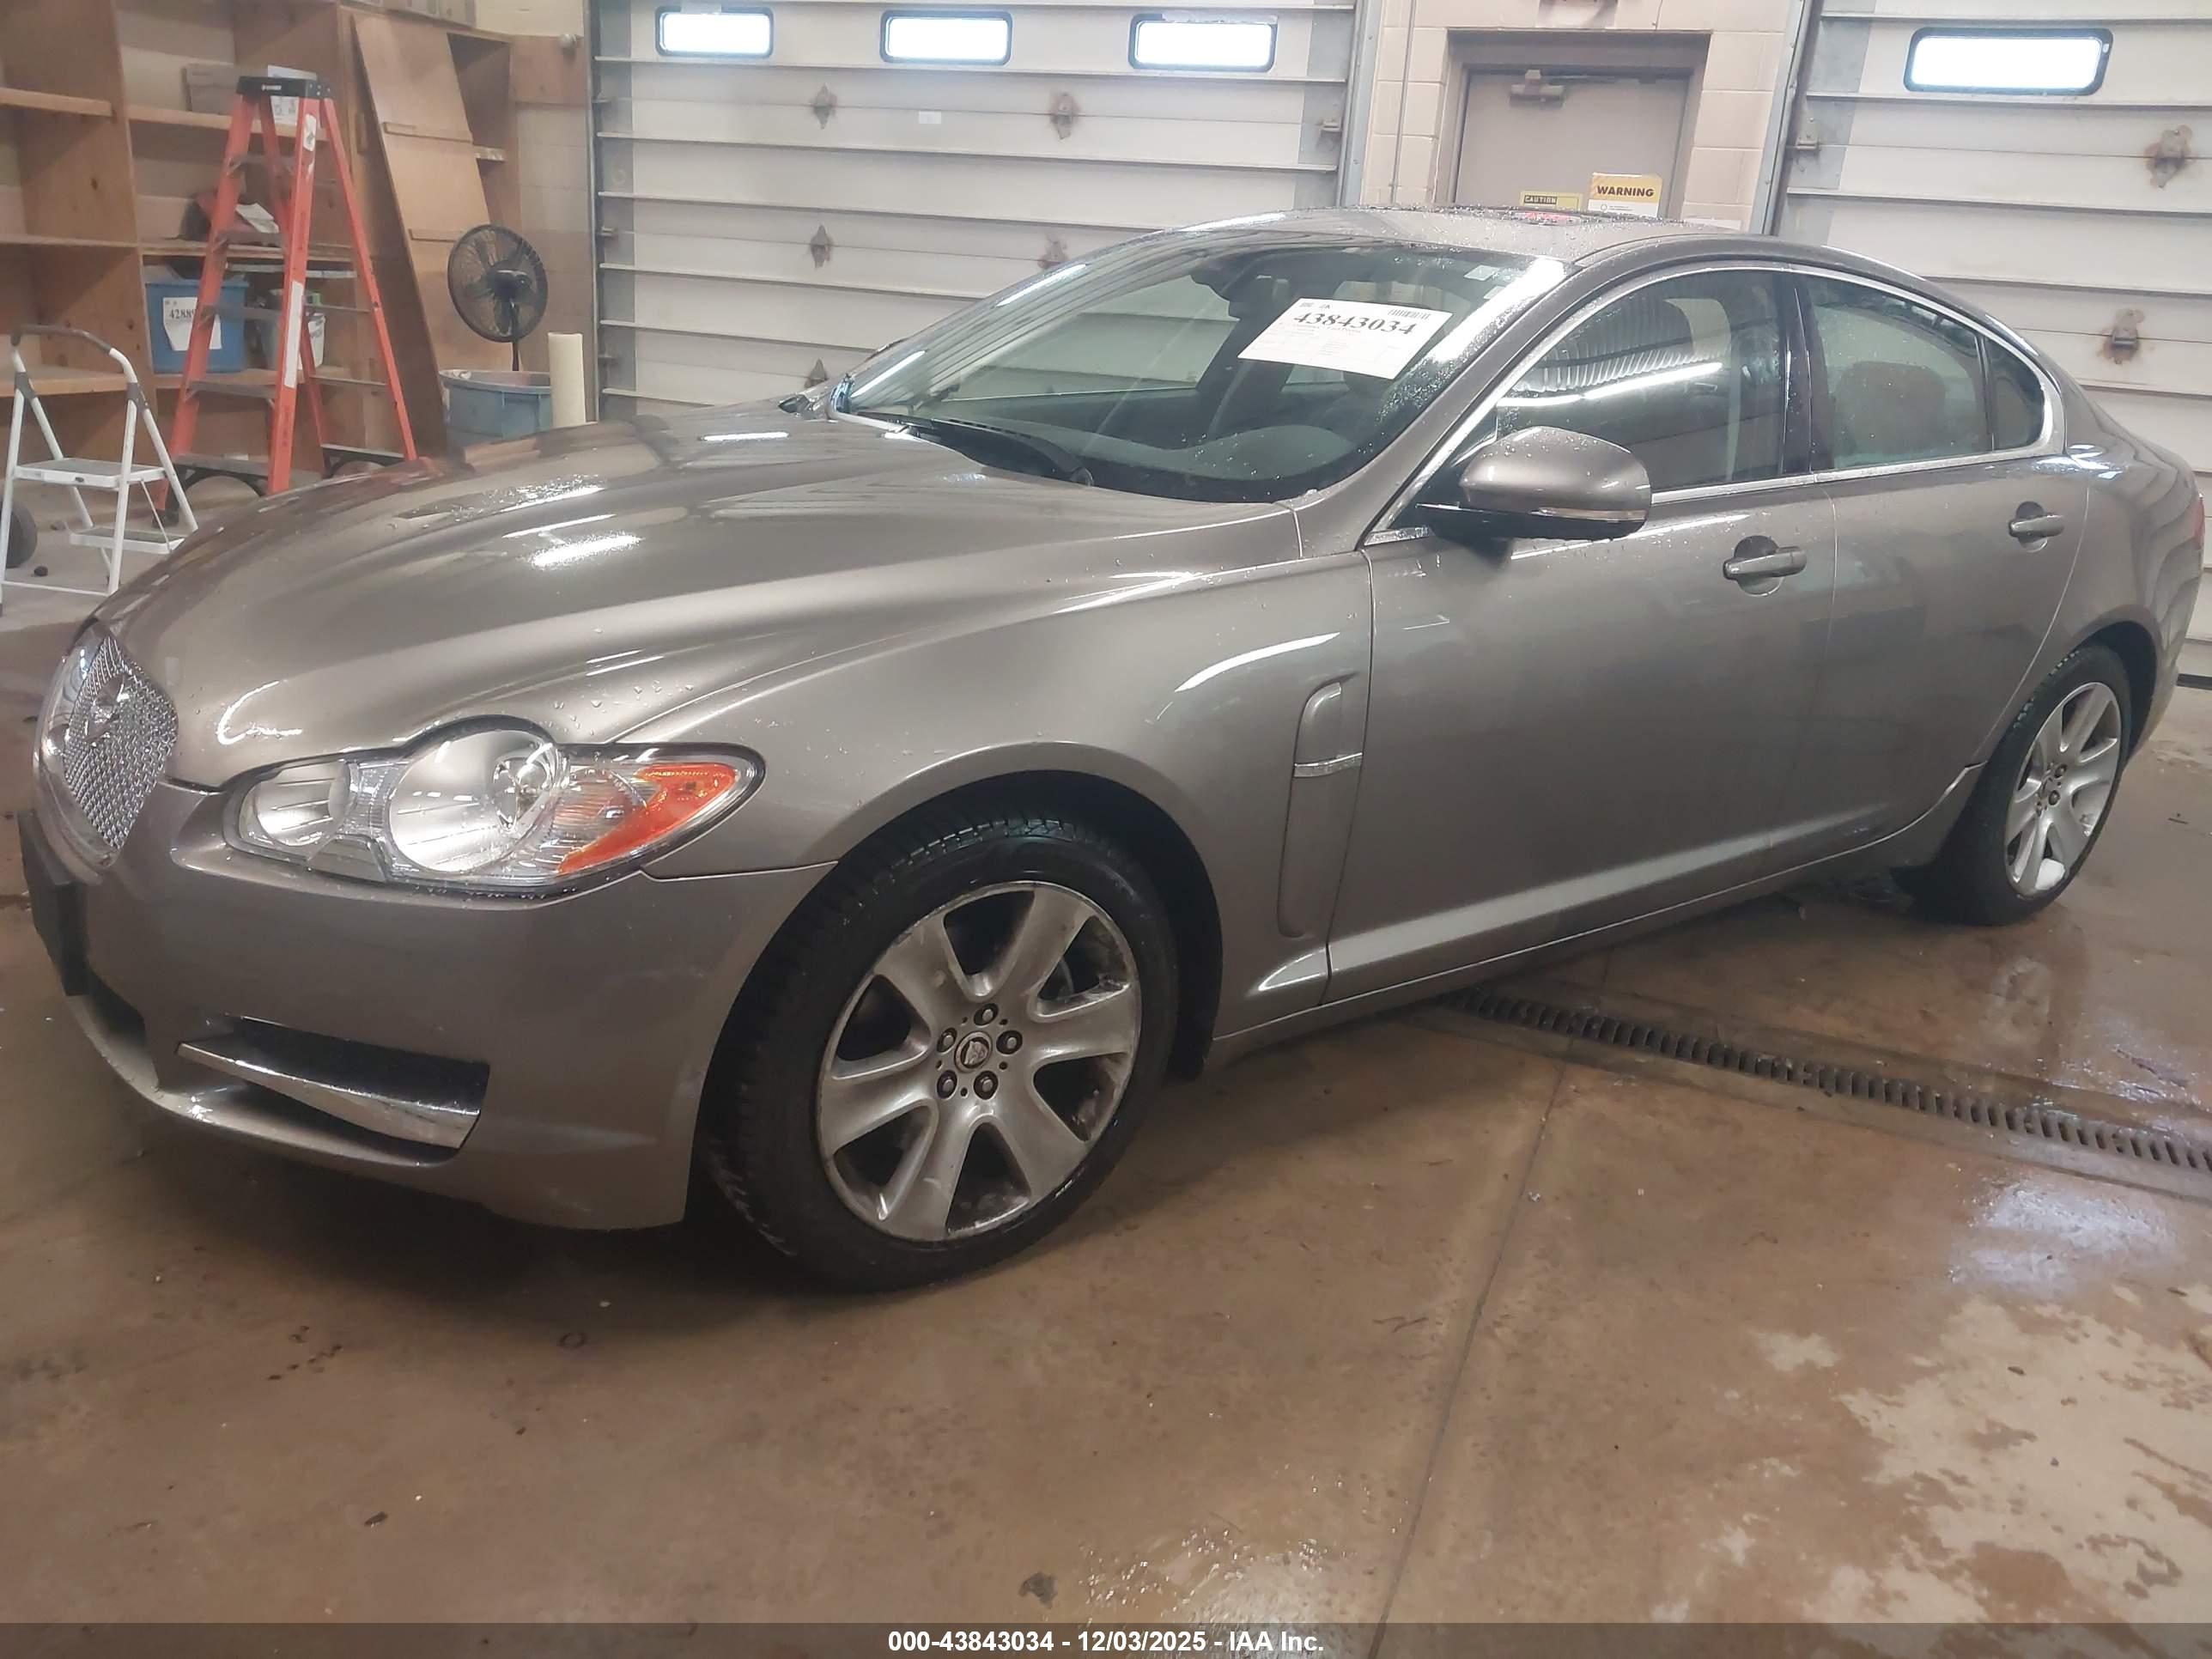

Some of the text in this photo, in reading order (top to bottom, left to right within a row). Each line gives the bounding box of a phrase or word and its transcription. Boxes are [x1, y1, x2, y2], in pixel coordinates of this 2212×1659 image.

[1596, 185, 1655, 198] WARNING
[1524, 195, 1557, 204] CAUTION
[1293, 312, 1417, 335] 43843034
